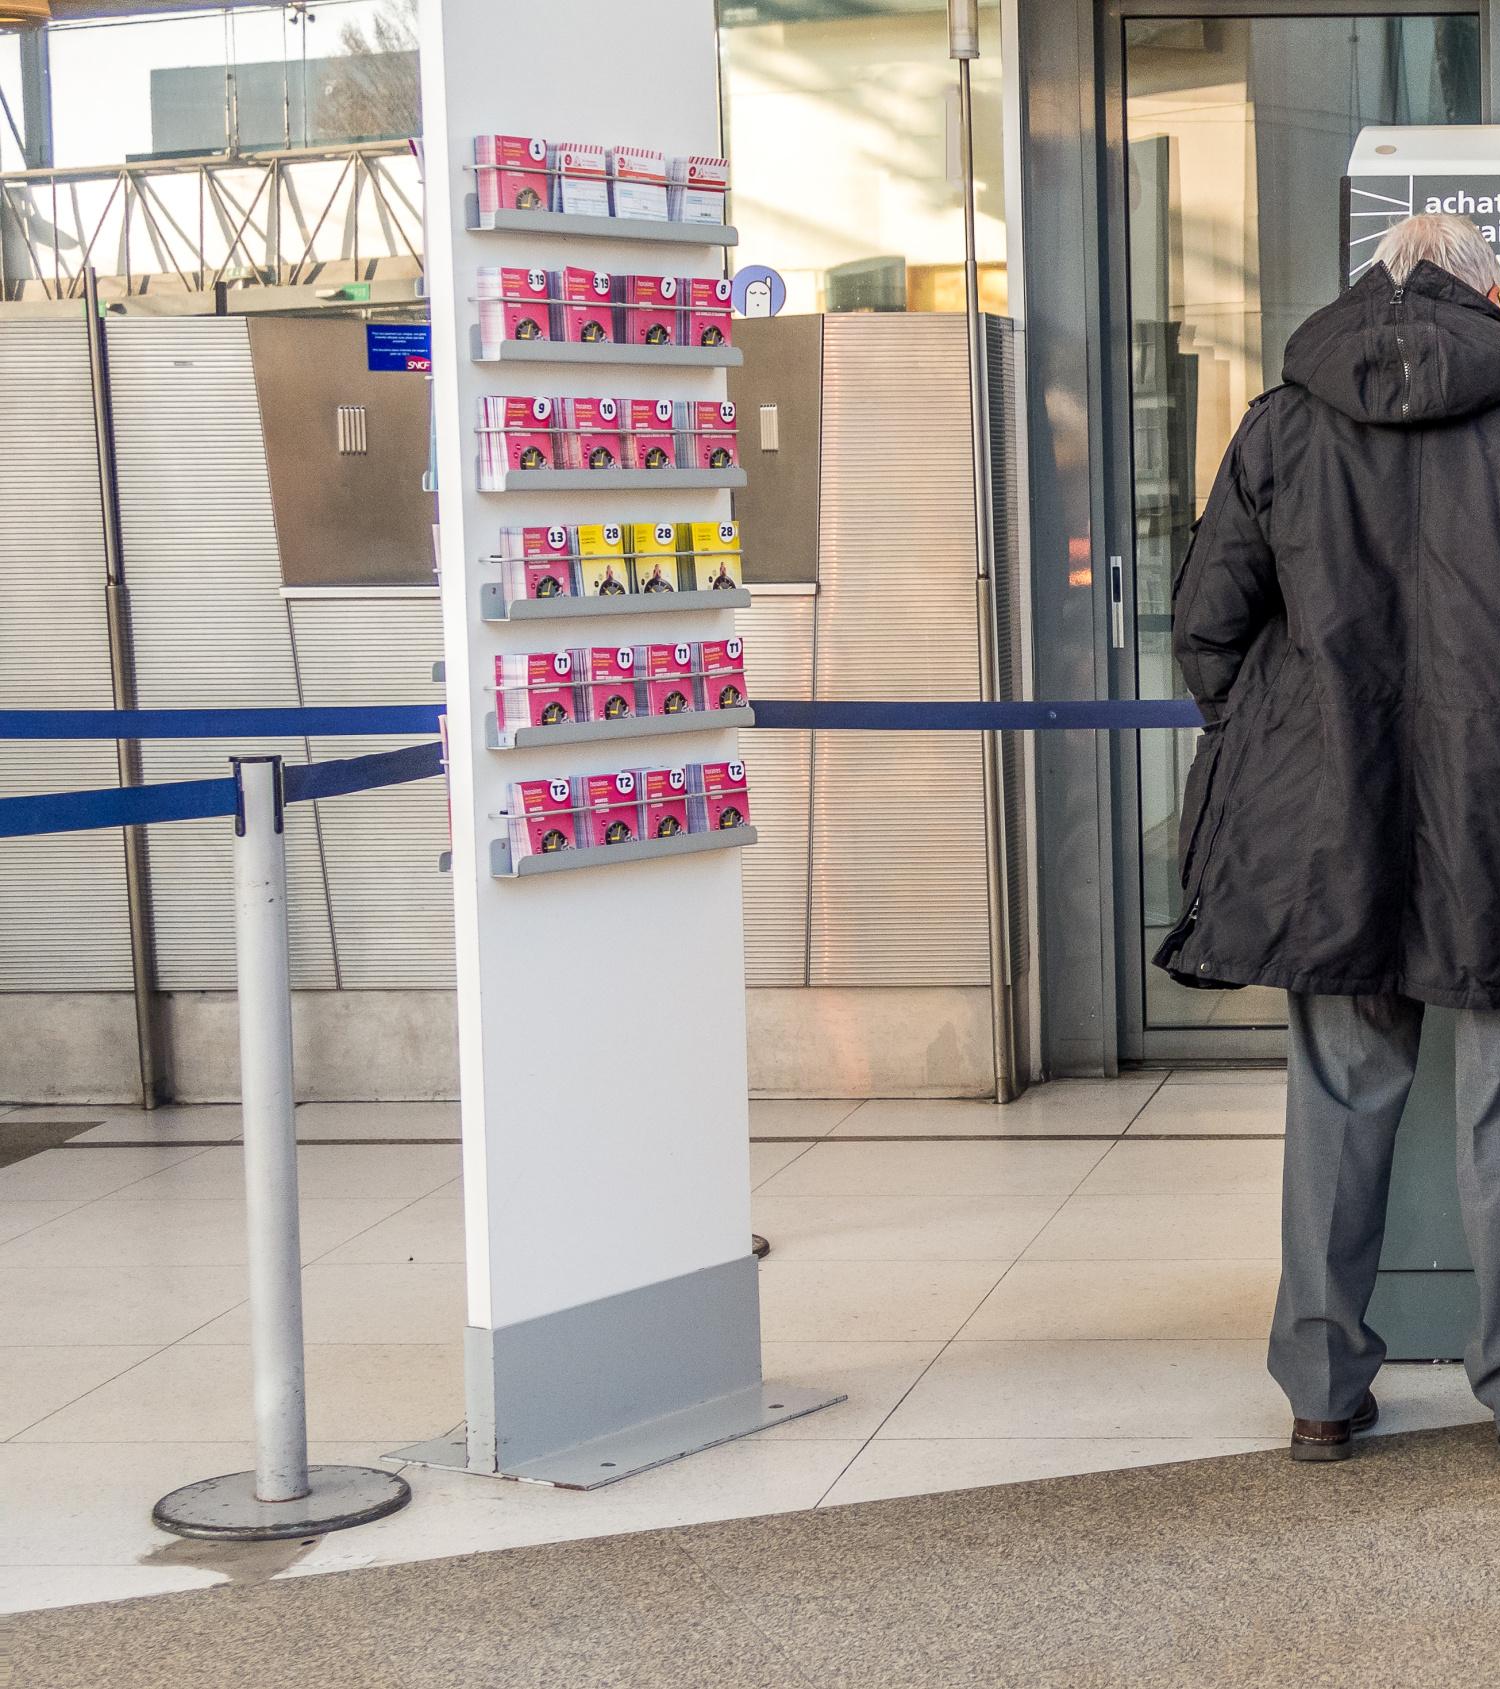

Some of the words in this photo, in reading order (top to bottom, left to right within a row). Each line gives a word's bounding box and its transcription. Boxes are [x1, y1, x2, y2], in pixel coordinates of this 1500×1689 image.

[535, 144, 541, 154] 1
[665, 282, 671, 292] 7
[720, 284, 727, 295] 8
[538, 403, 545, 413] 9
[602, 404, 613, 415] 10
[660, 404, 668, 415] 11
[722, 406, 733, 416] 12
[606, 528, 618, 539] 28
[657, 528, 672, 539] 28
[721, 526, 733, 537] 28
[550, 532, 564, 543] 13
[678, 648, 687, 659] T1
[729, 643, 739, 653] T1
[557, 657, 567, 669] T1
[620, 652, 630, 663] T1
[730, 765, 742, 776] T2
[618, 777, 631, 788] T2
[671, 773, 681, 784] T2
[552, 784, 566, 796] T2
